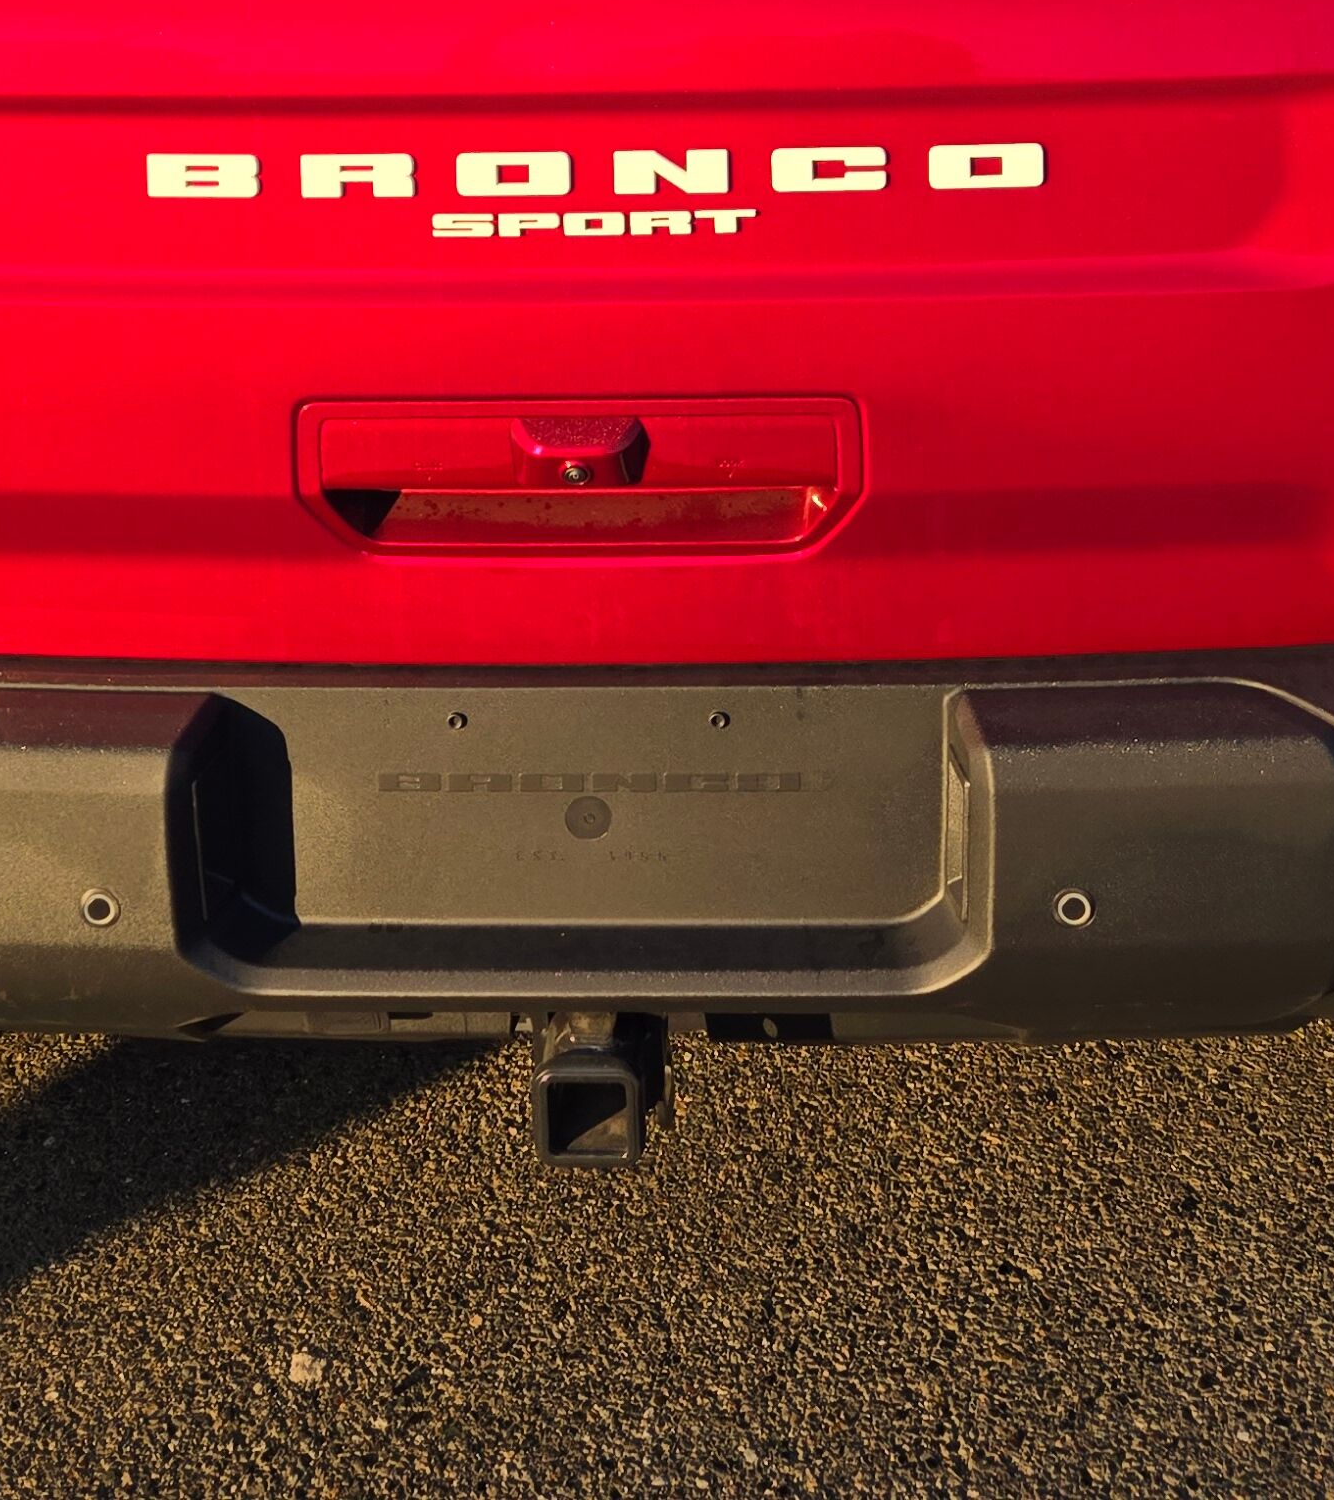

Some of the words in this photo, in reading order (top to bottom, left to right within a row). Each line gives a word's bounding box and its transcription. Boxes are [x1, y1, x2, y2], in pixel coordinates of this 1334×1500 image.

[145, 141, 1046, 199] BRONCO
[431, 208, 758, 239] SPORT
[377, 771, 803, 793] BRONCO
